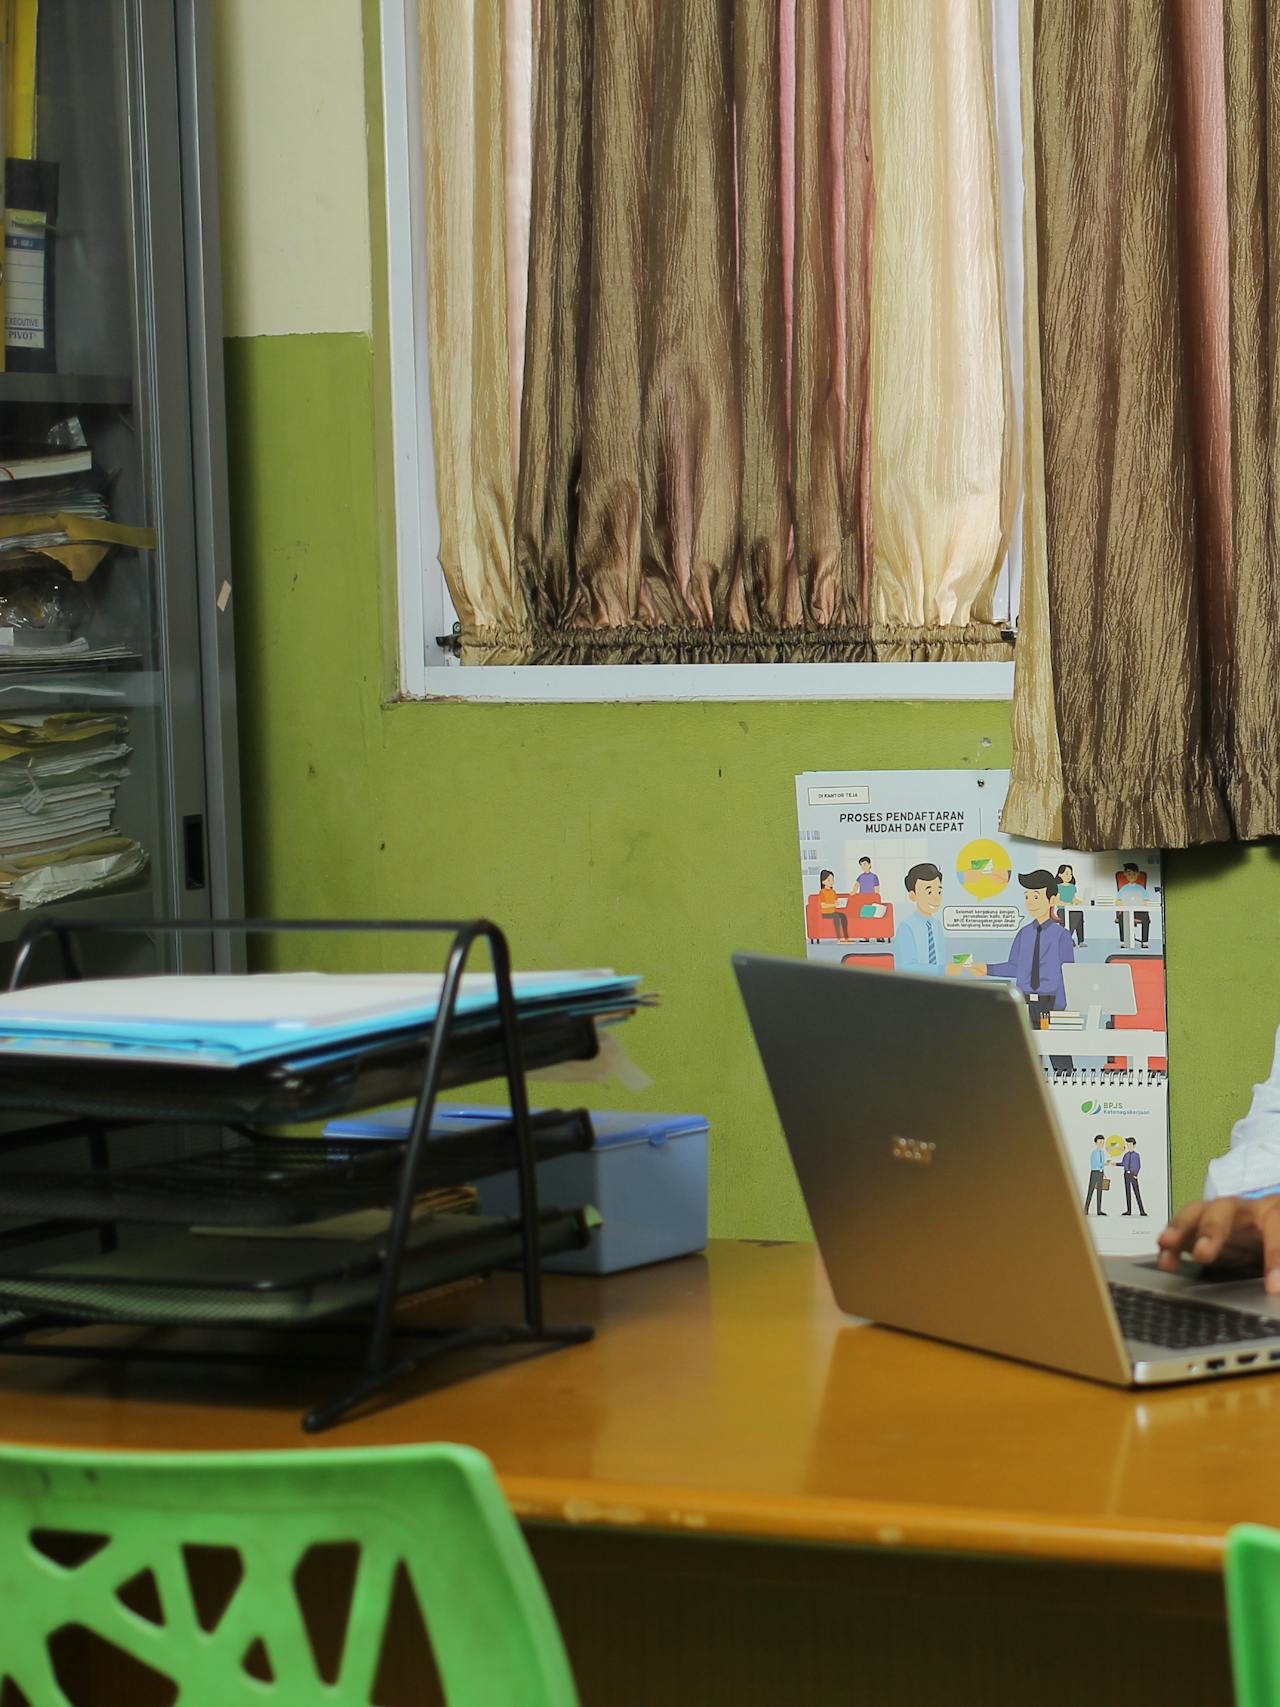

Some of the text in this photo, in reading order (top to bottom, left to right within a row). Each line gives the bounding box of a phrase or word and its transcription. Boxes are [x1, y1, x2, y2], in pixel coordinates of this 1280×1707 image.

[8, 330, 36, 340] PIVOT
[839, 811, 964, 823] PROSES PENDAFTARAN
[865, 822, 964, 833] MUDAH DAN CEPAT
